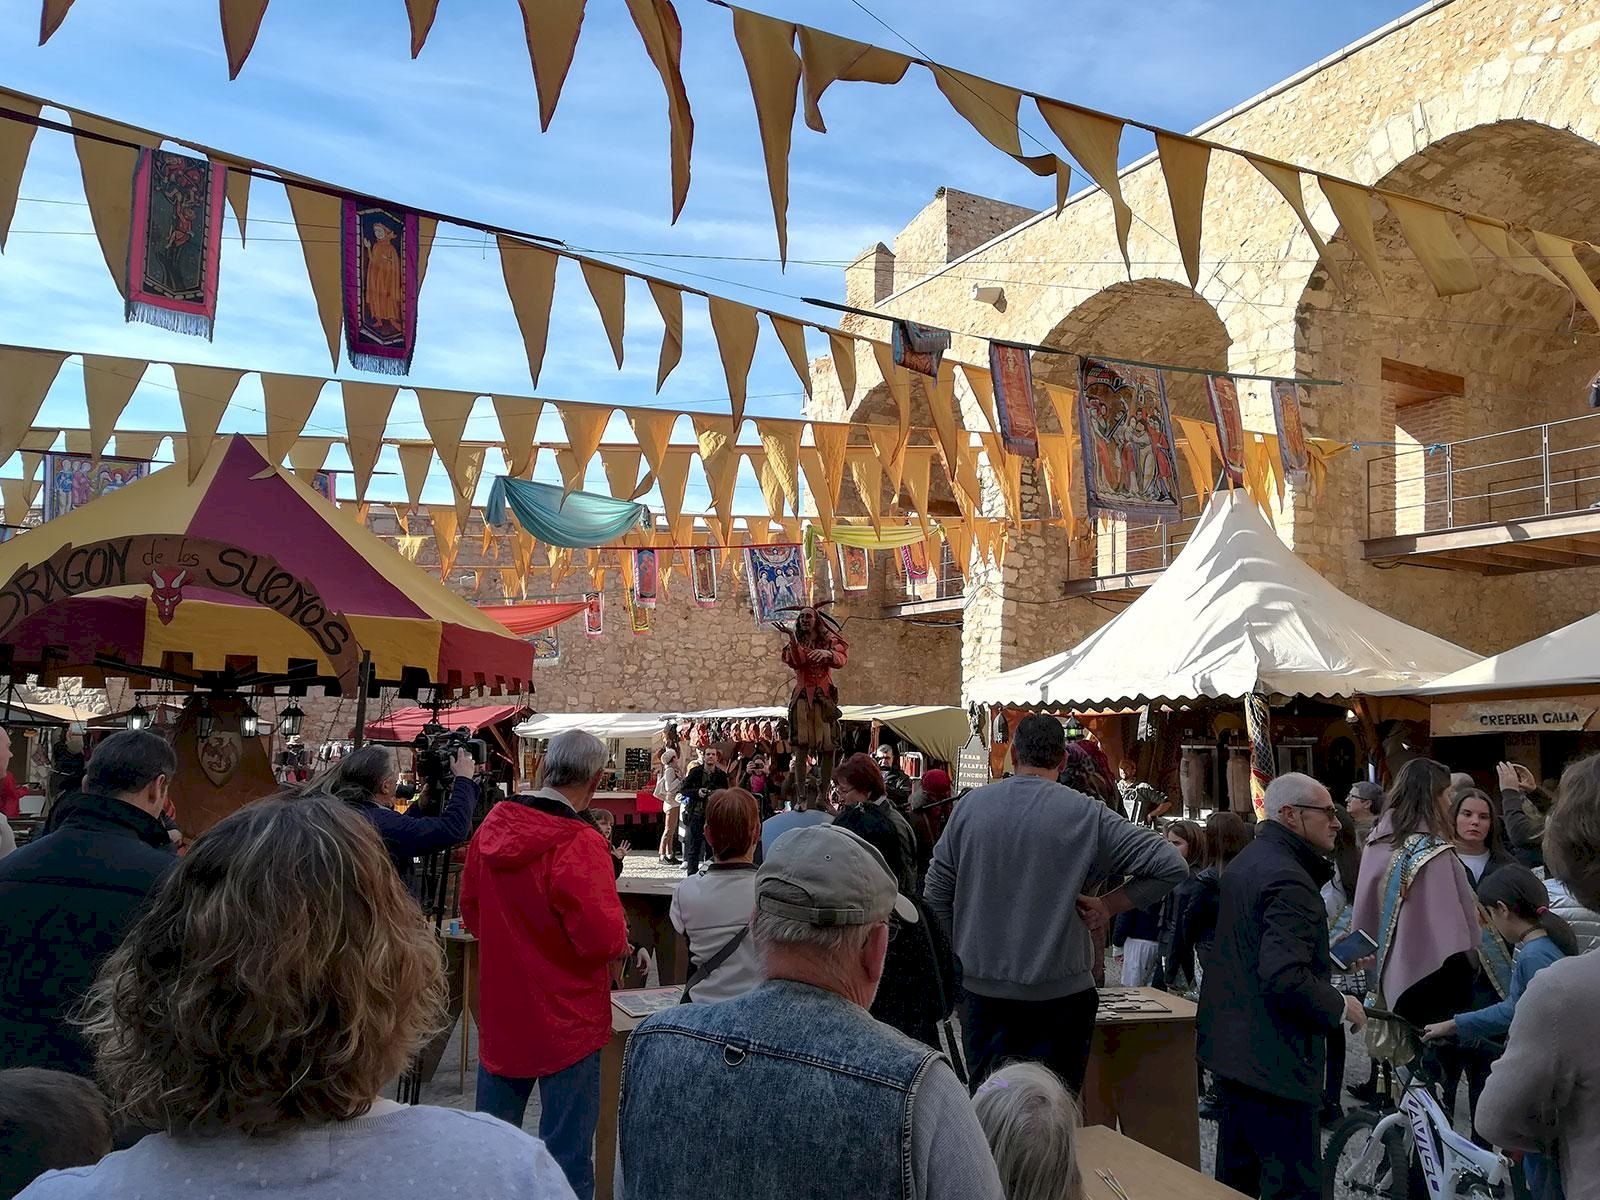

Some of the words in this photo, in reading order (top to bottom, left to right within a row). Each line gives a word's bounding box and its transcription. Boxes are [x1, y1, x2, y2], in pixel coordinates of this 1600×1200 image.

[142, 539, 163, 566] de
[177, 538, 200, 567] los
[1480, 713, 1538, 726] CREPERIA
[1542, 712, 1579, 724] GALIA
